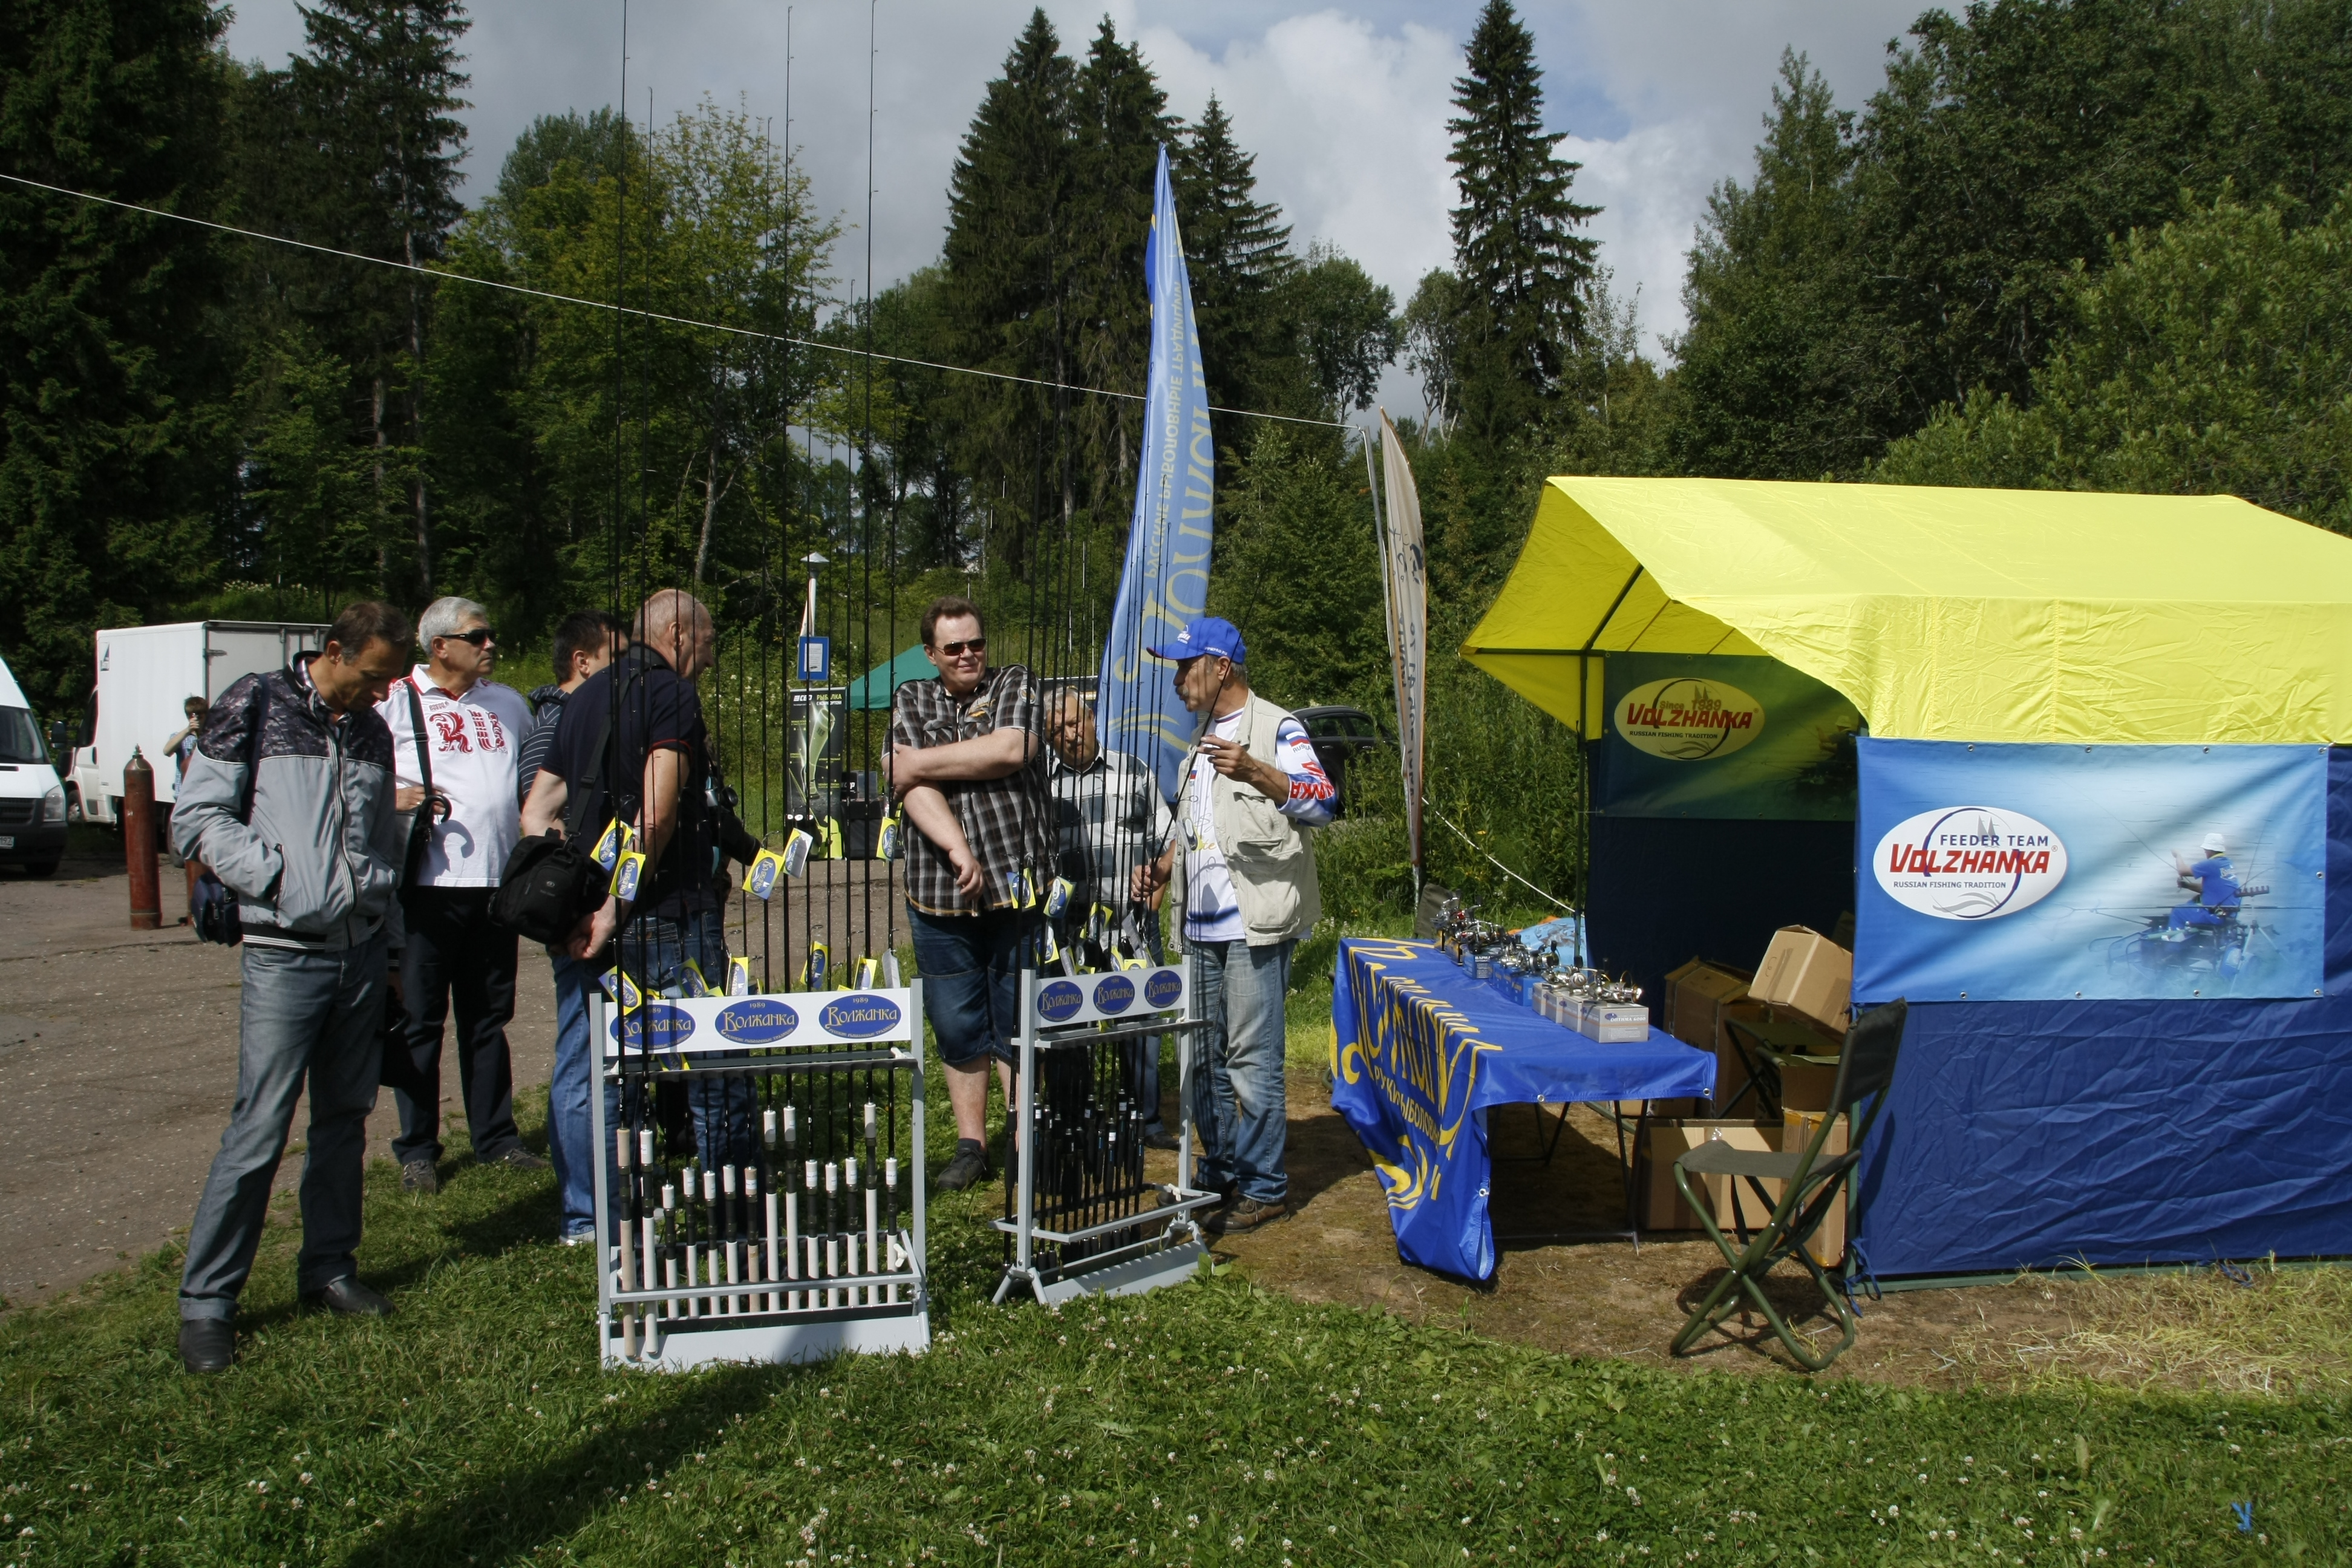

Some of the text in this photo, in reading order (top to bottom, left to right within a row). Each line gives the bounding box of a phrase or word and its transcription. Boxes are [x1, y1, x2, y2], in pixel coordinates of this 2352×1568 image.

[1627, 703, 1753, 730] VOLZHANKA
[1659, 700, 1685, 710] Since
[1940, 834, 2049, 847] FEEDER TEAM
[1889, 843, 2051, 874] VOLZHANKA
[616, 1016, 691, 1039] Вожанка
[720, 1011, 795, 1034] Волжанка
[825, 1006, 898, 1029] Волжанка
